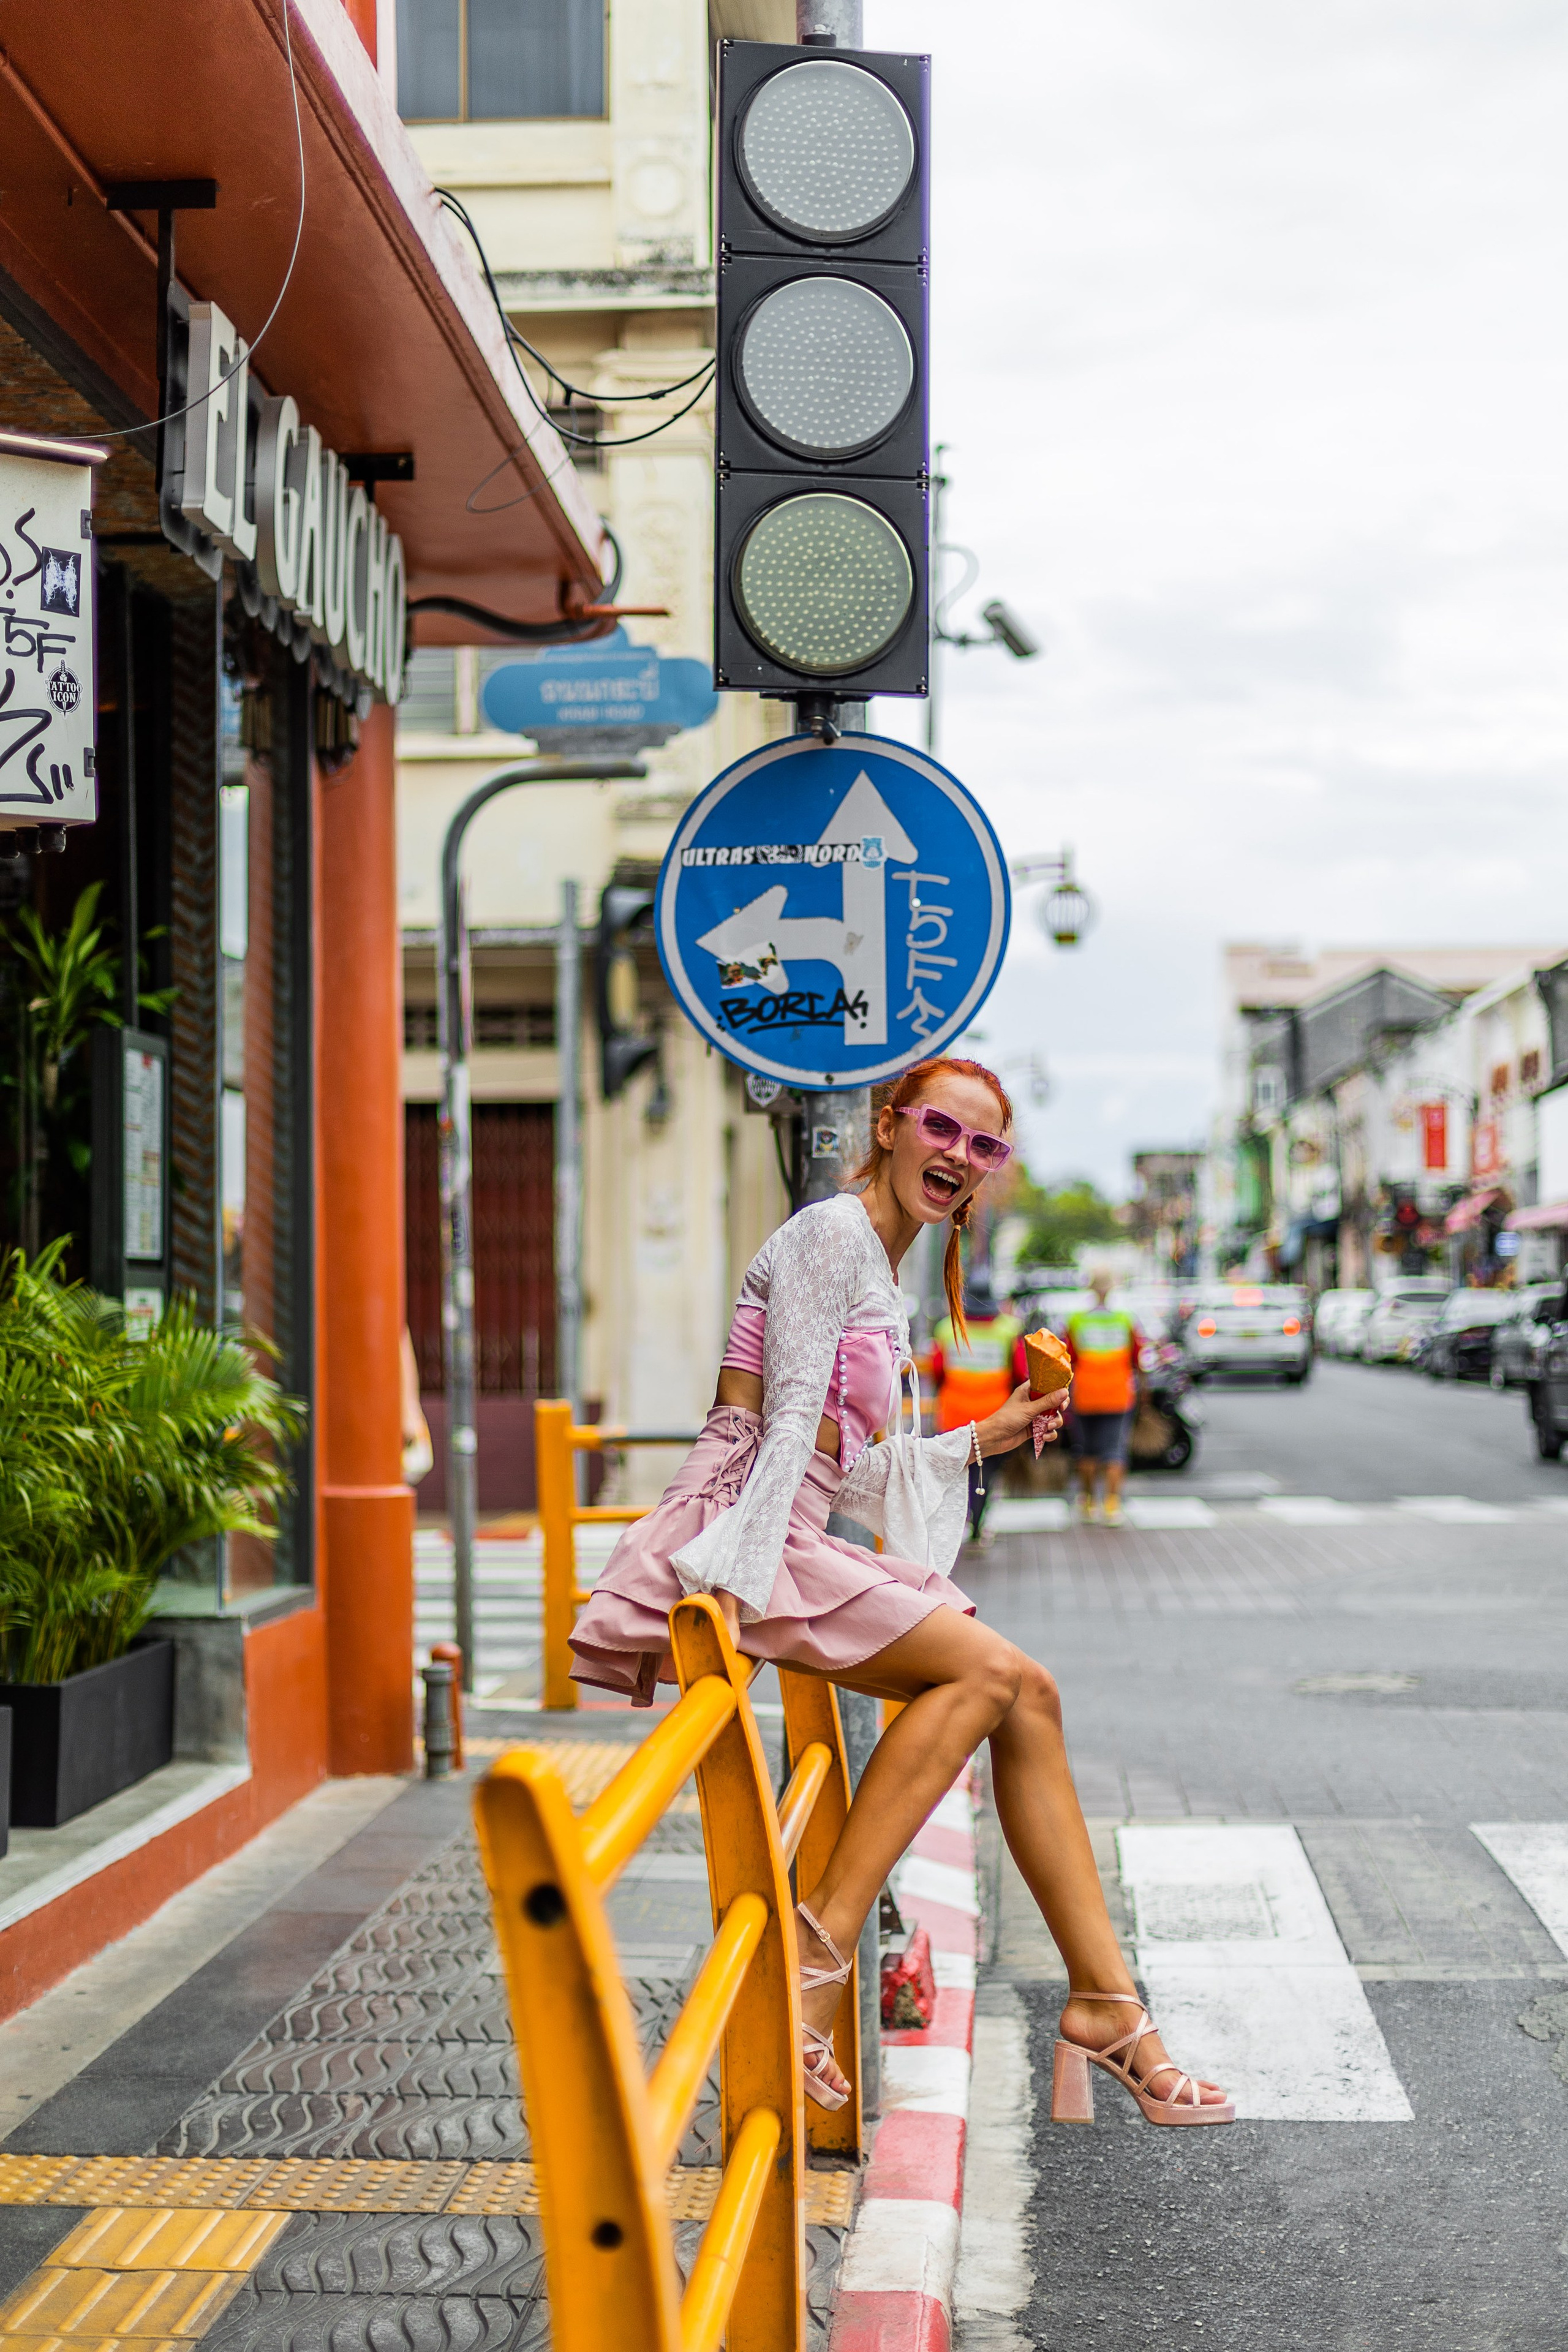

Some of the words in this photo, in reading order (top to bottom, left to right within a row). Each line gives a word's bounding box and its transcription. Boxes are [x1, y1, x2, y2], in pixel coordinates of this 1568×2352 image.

[193, 300, 257, 562] EL
[268, 395, 407, 706] GAUCHO
[45, 680, 83, 693] TATTOO
[53, 691, 77, 703] ICON
[682, 846, 755, 866] ULTRAS
[804, 845, 861, 862] NORD
